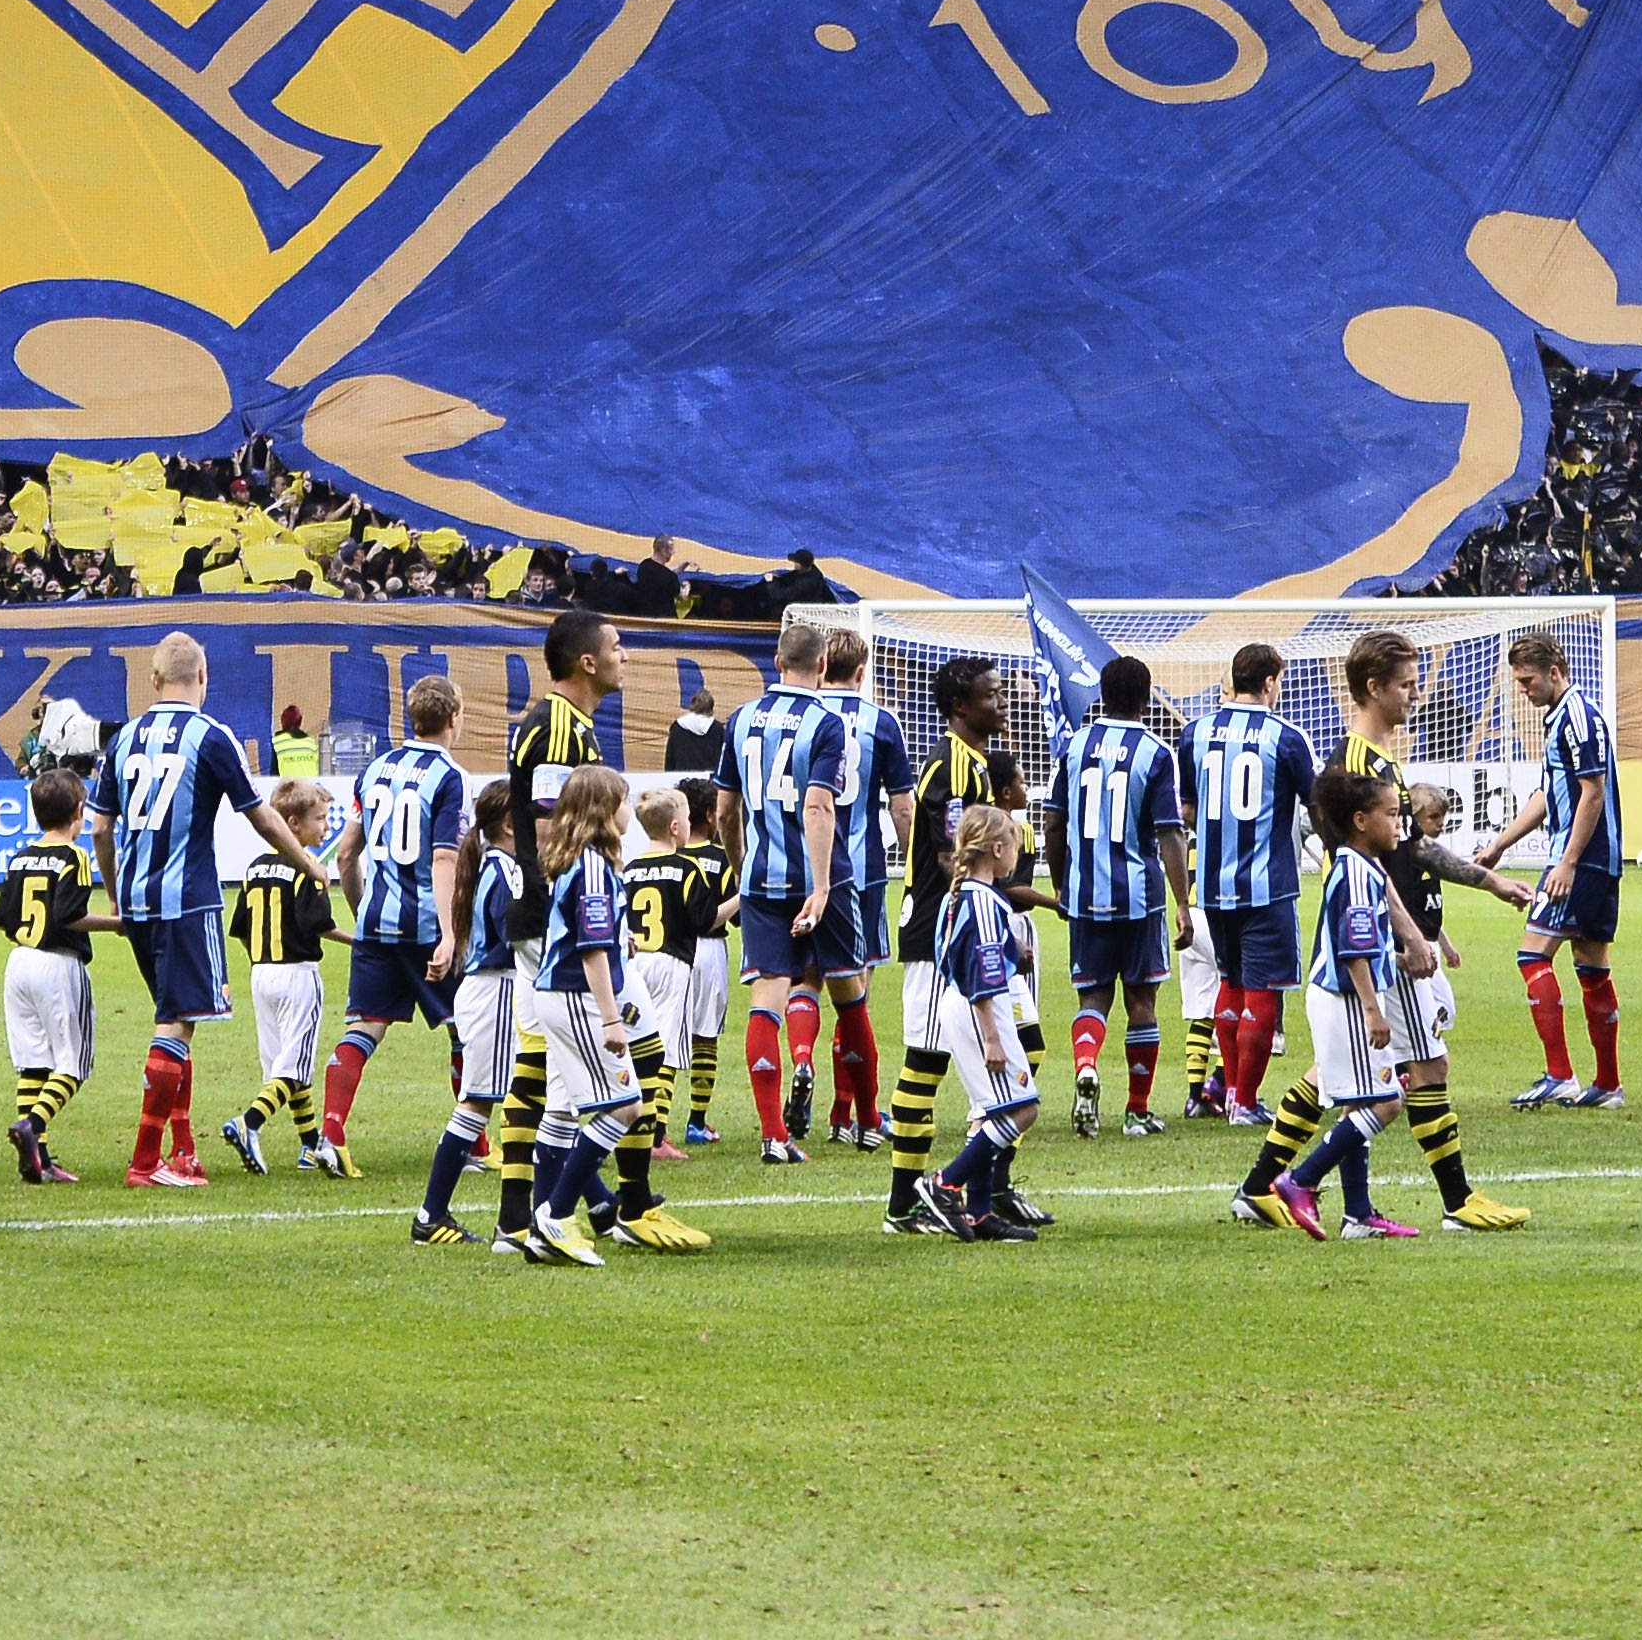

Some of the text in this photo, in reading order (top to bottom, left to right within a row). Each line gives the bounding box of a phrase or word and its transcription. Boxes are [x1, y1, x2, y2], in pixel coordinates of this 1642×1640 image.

[742, 736, 800, 812] 14
[1090, 741, 1128, 761] JAWO
[1202, 750, 1263, 821] 10
[123, 753, 187, 831] 27
[364, 784, 421, 865] 20
[1080, 767, 1128, 843] 11
[15, 876, 49, 948] 5
[246, 886, 284, 962] 11
[632, 887, 665, 952] 3
